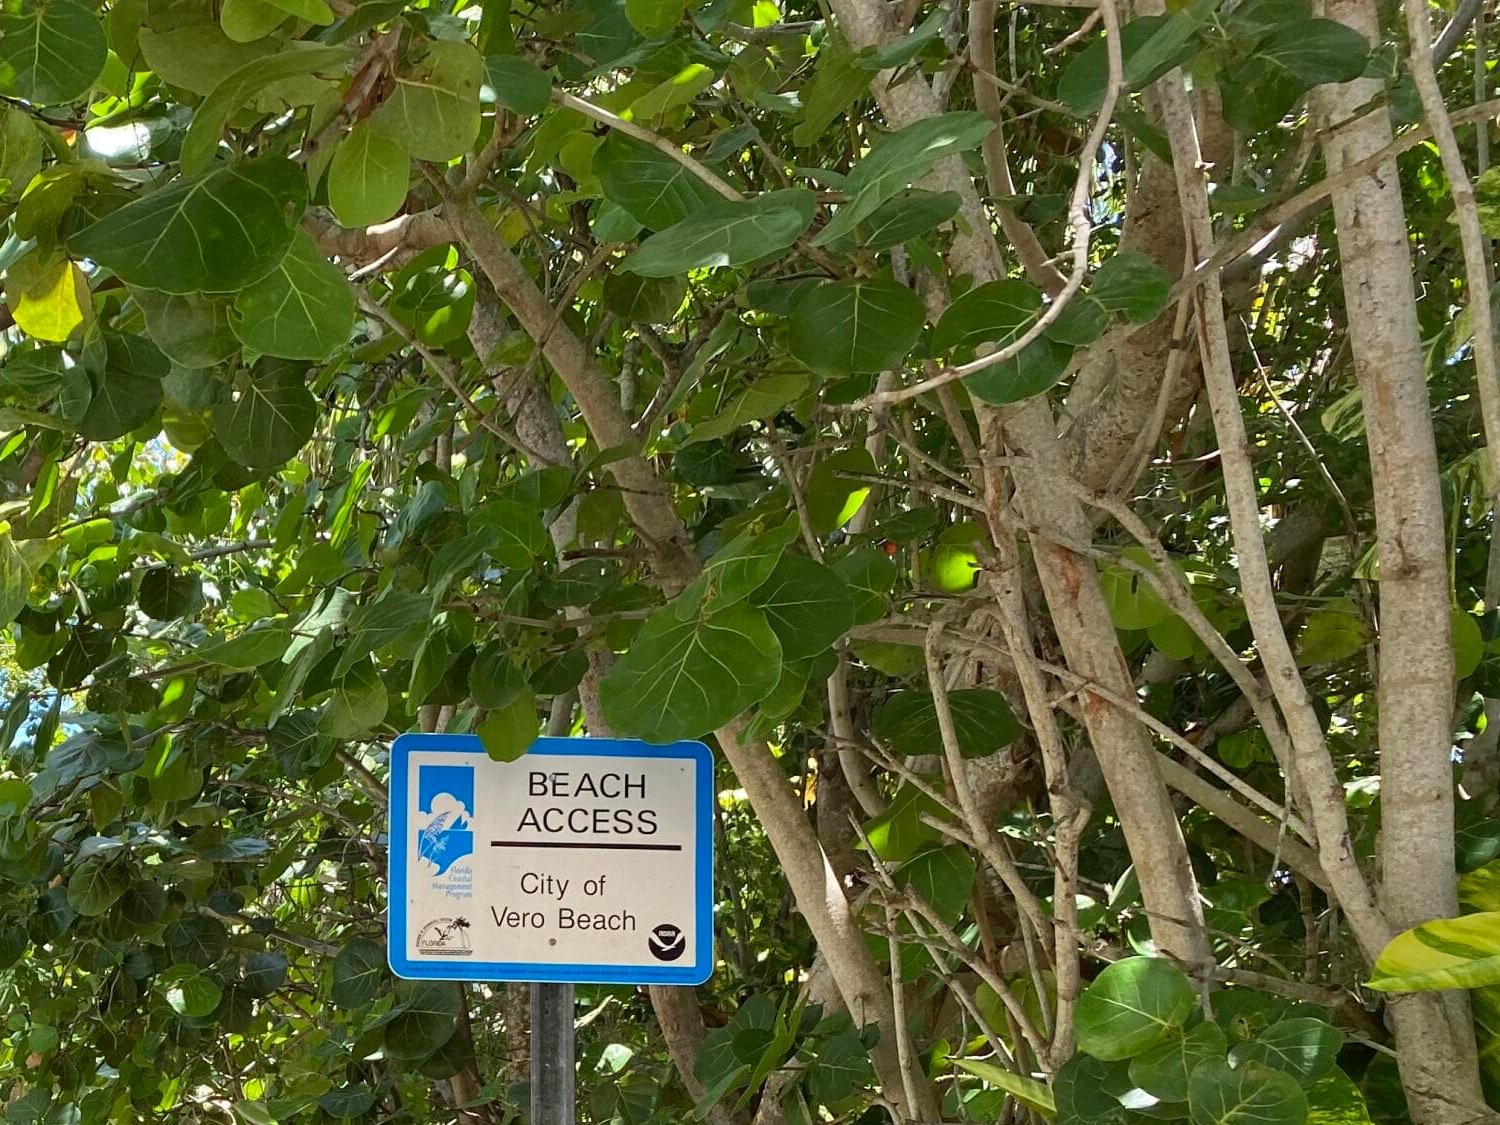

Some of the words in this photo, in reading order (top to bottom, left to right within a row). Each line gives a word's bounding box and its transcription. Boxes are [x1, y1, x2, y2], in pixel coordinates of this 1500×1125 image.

[528, 771, 646, 799] BEACH
[517, 807, 658, 835] ACCESS
[520, 872, 569, 900] City
[583, 875, 606, 896] of
[491, 905, 545, 928] Vero
[558, 907, 636, 931] Beach
